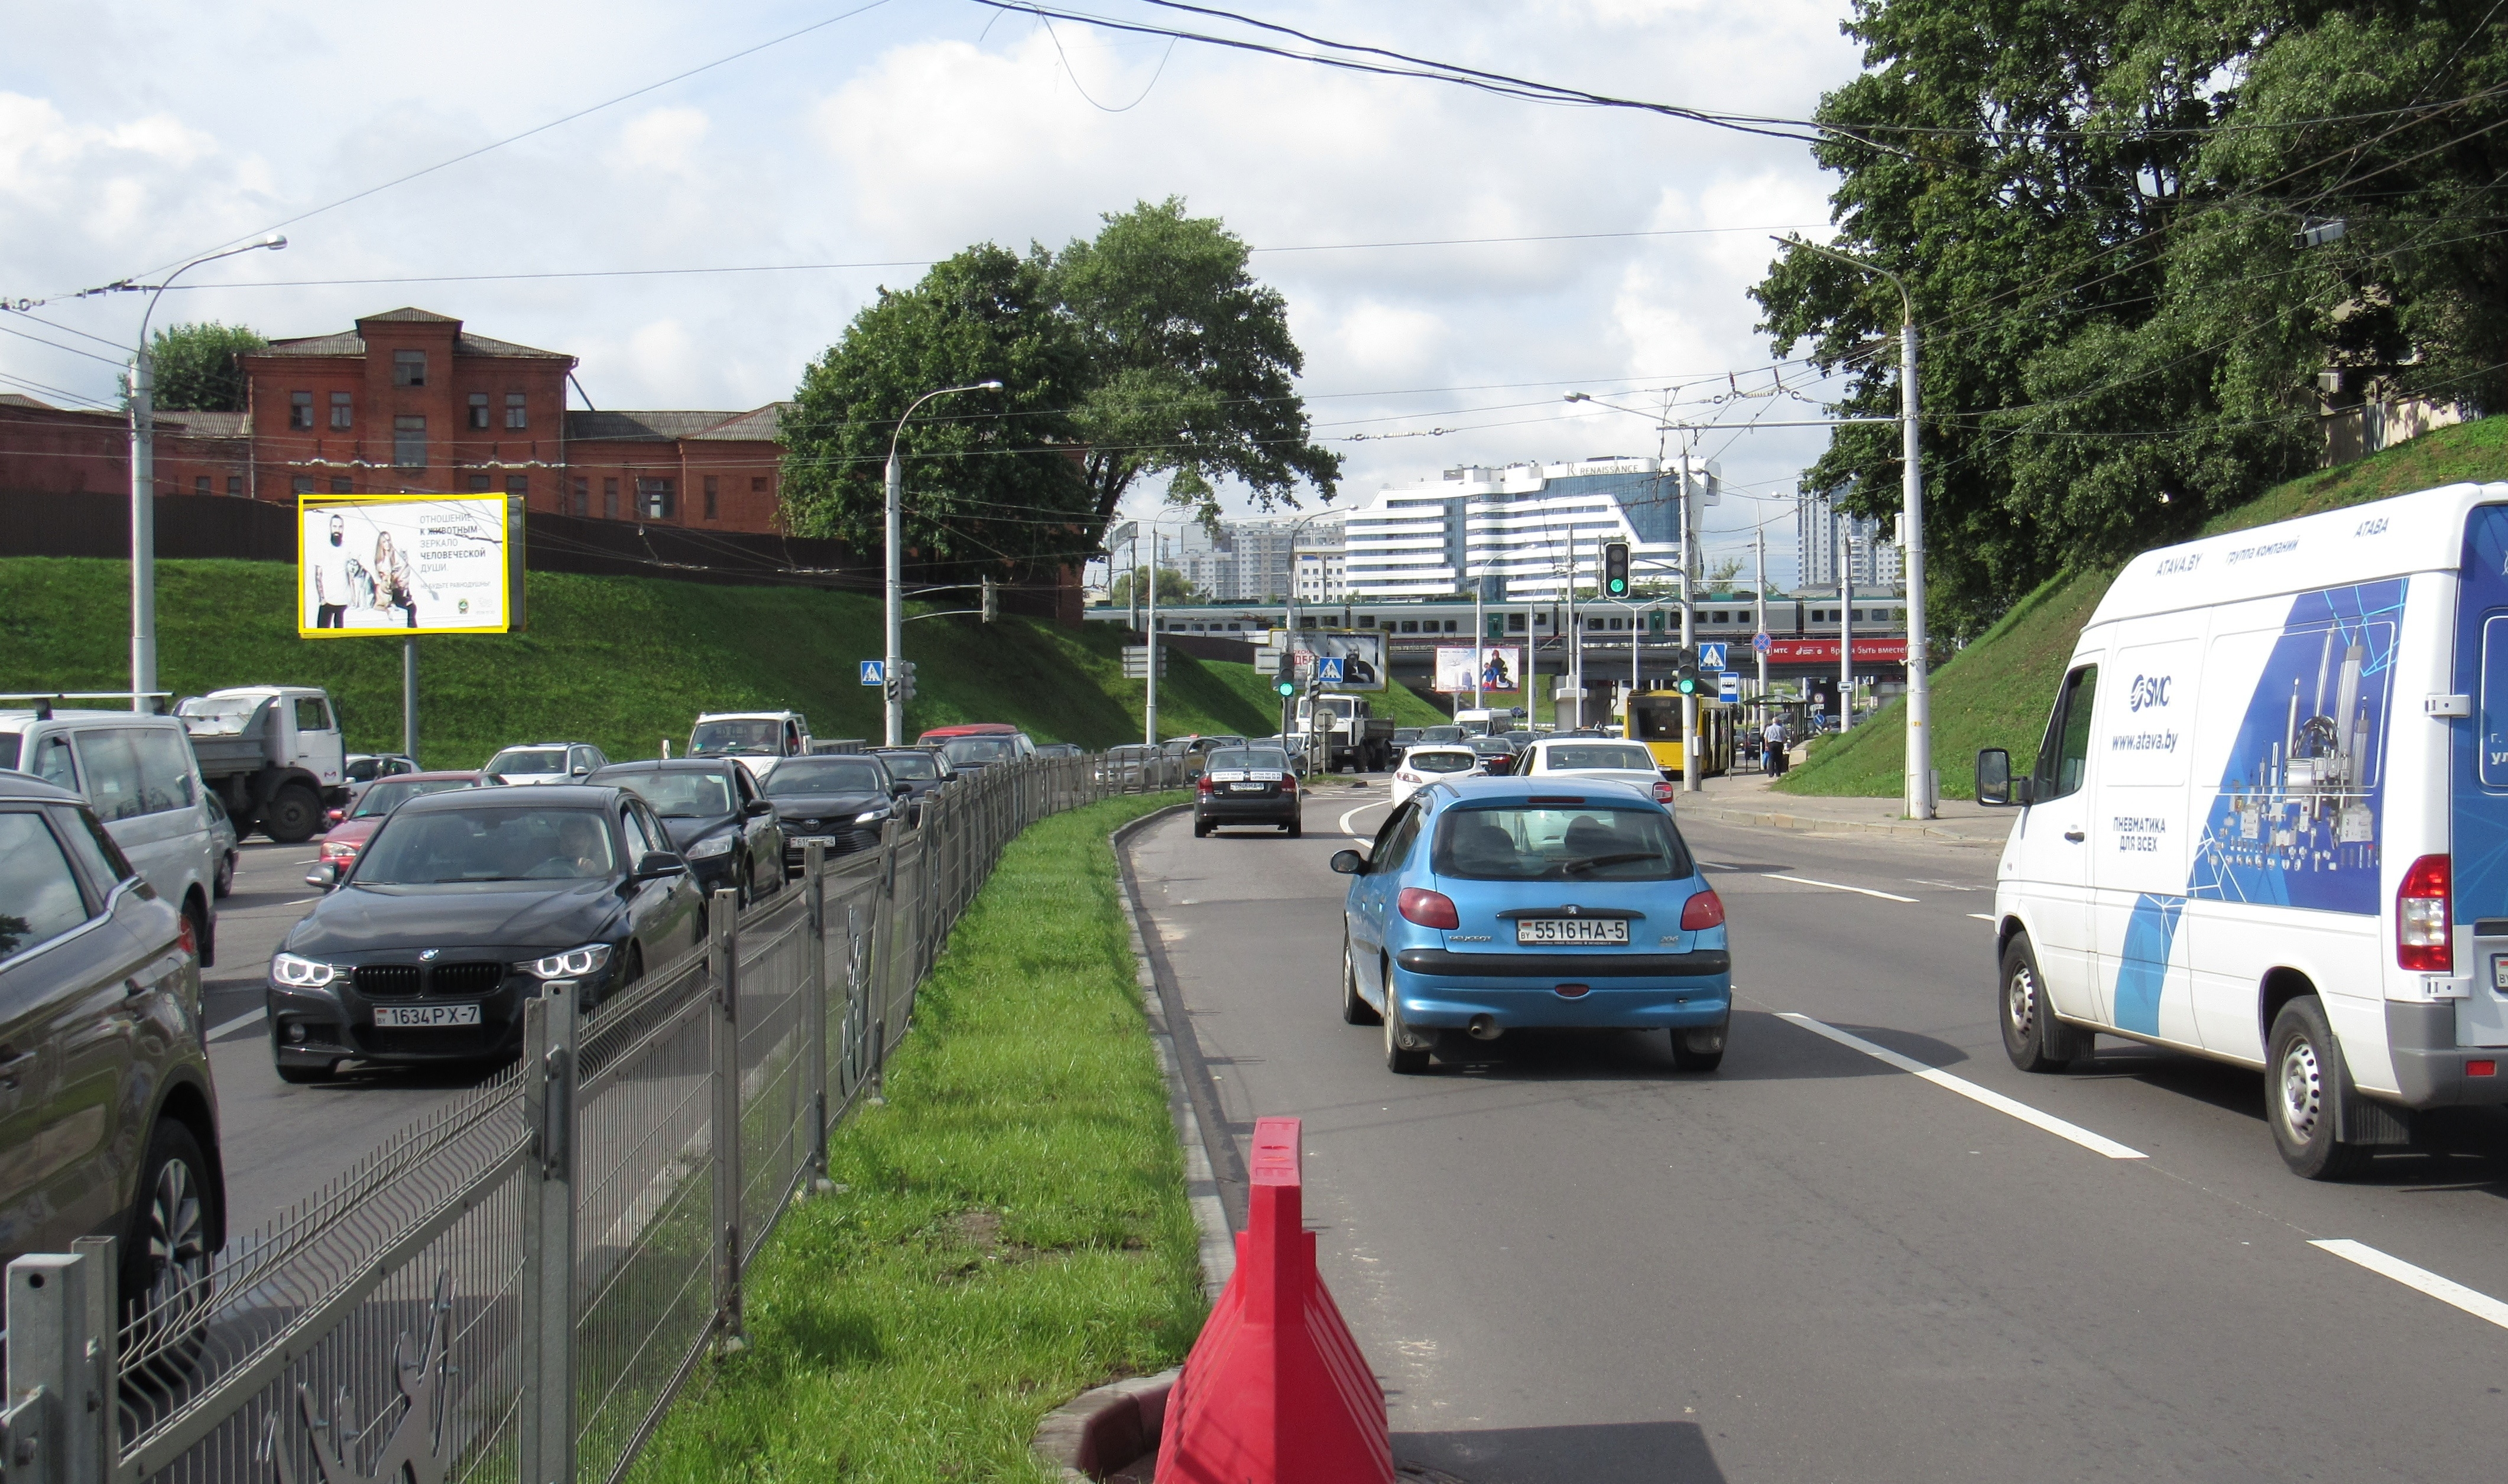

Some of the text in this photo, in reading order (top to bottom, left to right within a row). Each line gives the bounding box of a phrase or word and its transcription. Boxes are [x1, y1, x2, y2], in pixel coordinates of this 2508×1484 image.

[1580, 465, 1639, 476] RENAISSANCE
[420, 514, 472, 524] ОТНОШЕНИЕ
[2353, 517, 2389, 538] АТАВА
[420, 538, 458, 548] ЗЕРКАЛО
[2225, 535, 2301, 566] группа компаний
[420, 547, 486, 560] ЧЕЛОВЕЧЕСКОЙ
[2155, 553, 2204, 577] ATAVA.BY
[1857, 646, 1876, 654] быть
[2144, 675, 2172, 708] SMC
[2112, 728, 2179, 754] www.atava.by
[2113, 817, 2166, 833] ПНЕВМАТИКА
[2120, 835, 2158, 853] ДЛЯ ВСЕХ
